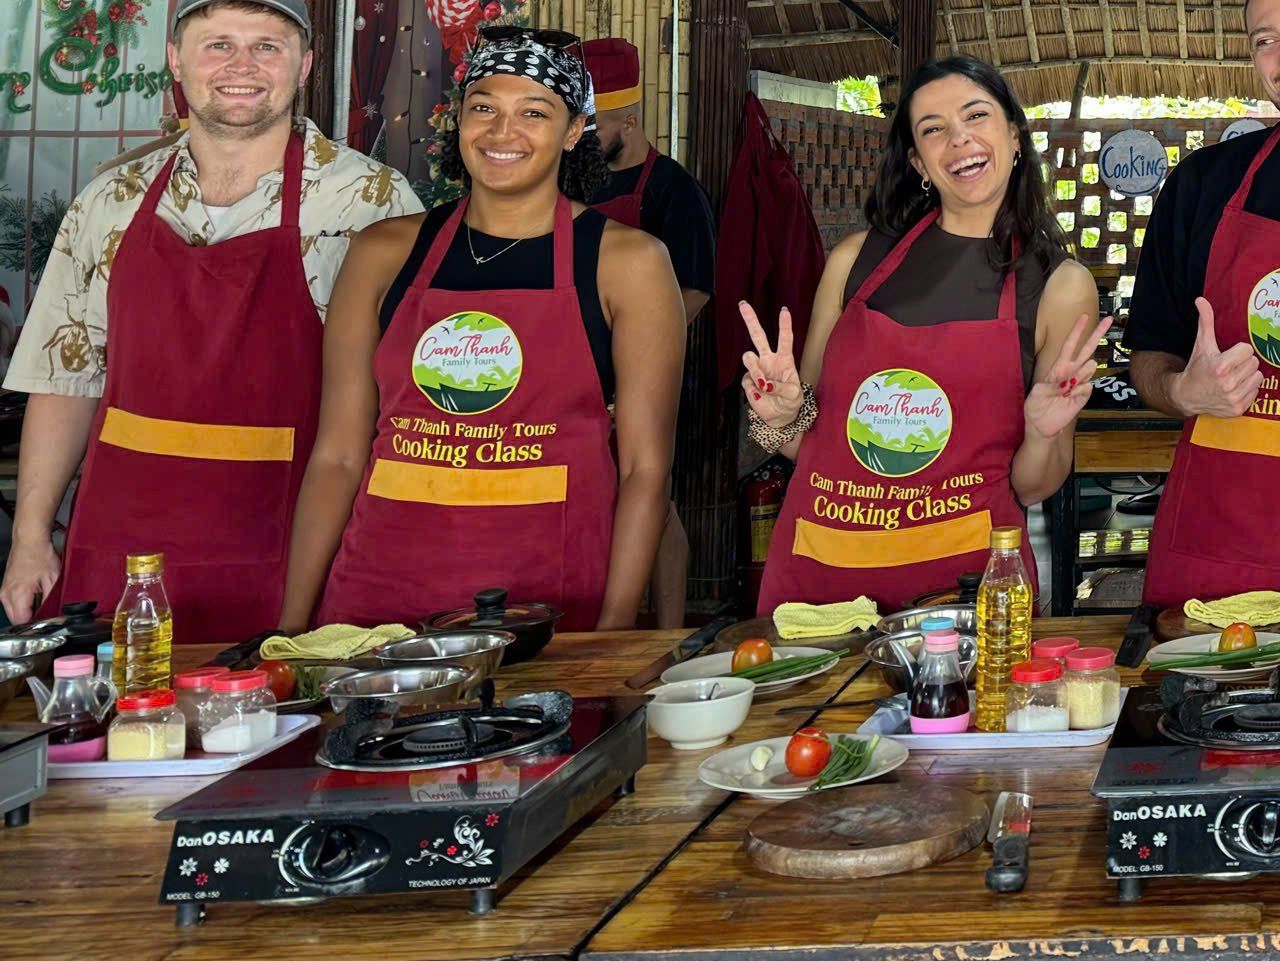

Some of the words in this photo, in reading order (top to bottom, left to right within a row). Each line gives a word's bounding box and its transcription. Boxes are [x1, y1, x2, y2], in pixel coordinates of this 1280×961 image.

[442, 357, 471, 367] Family
[474, 357, 497, 366] Tours
[412, 417, 450, 436] Thanh
[455, 422, 508, 440] Family
[512, 423, 557, 437] Tours
[873, 415, 901, 426] Family
[904, 417, 927, 426] Tours
[392, 434, 471, 468] Cooking
[475, 439, 543, 464] Class
[810, 472, 834, 493] Cam
[837, 480, 884, 500] Thanh
[814, 495, 902, 530] Cooking
[906, 493, 972, 521] Class
[1113, 803, 1206, 822] DanOSAKA
[177, 828, 275, 847] DanOSAKA
[408, 878, 457, 888] TECHNOLOGY
[457, 877, 468, 886] OF
[468, 876, 492, 885] JAPAN
